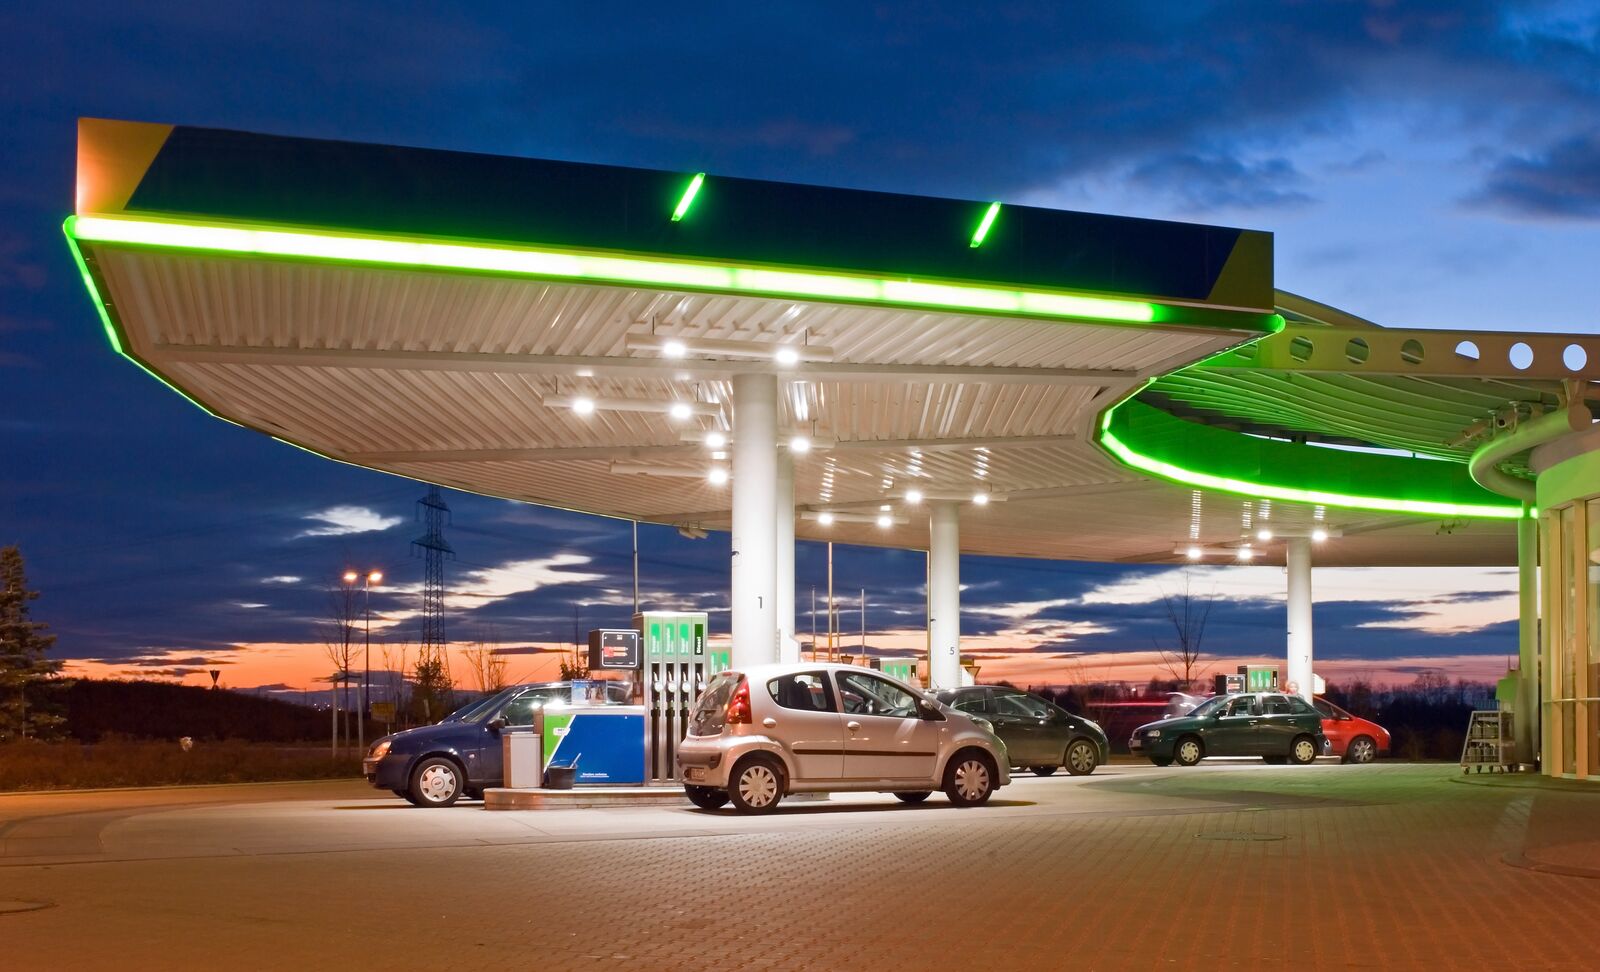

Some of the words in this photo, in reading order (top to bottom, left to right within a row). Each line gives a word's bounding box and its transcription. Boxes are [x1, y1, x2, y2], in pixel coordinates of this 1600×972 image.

[757, 596, 762, 609] 1
[950, 646, 955, 655] 5
[1304, 655, 1309, 663] 7
